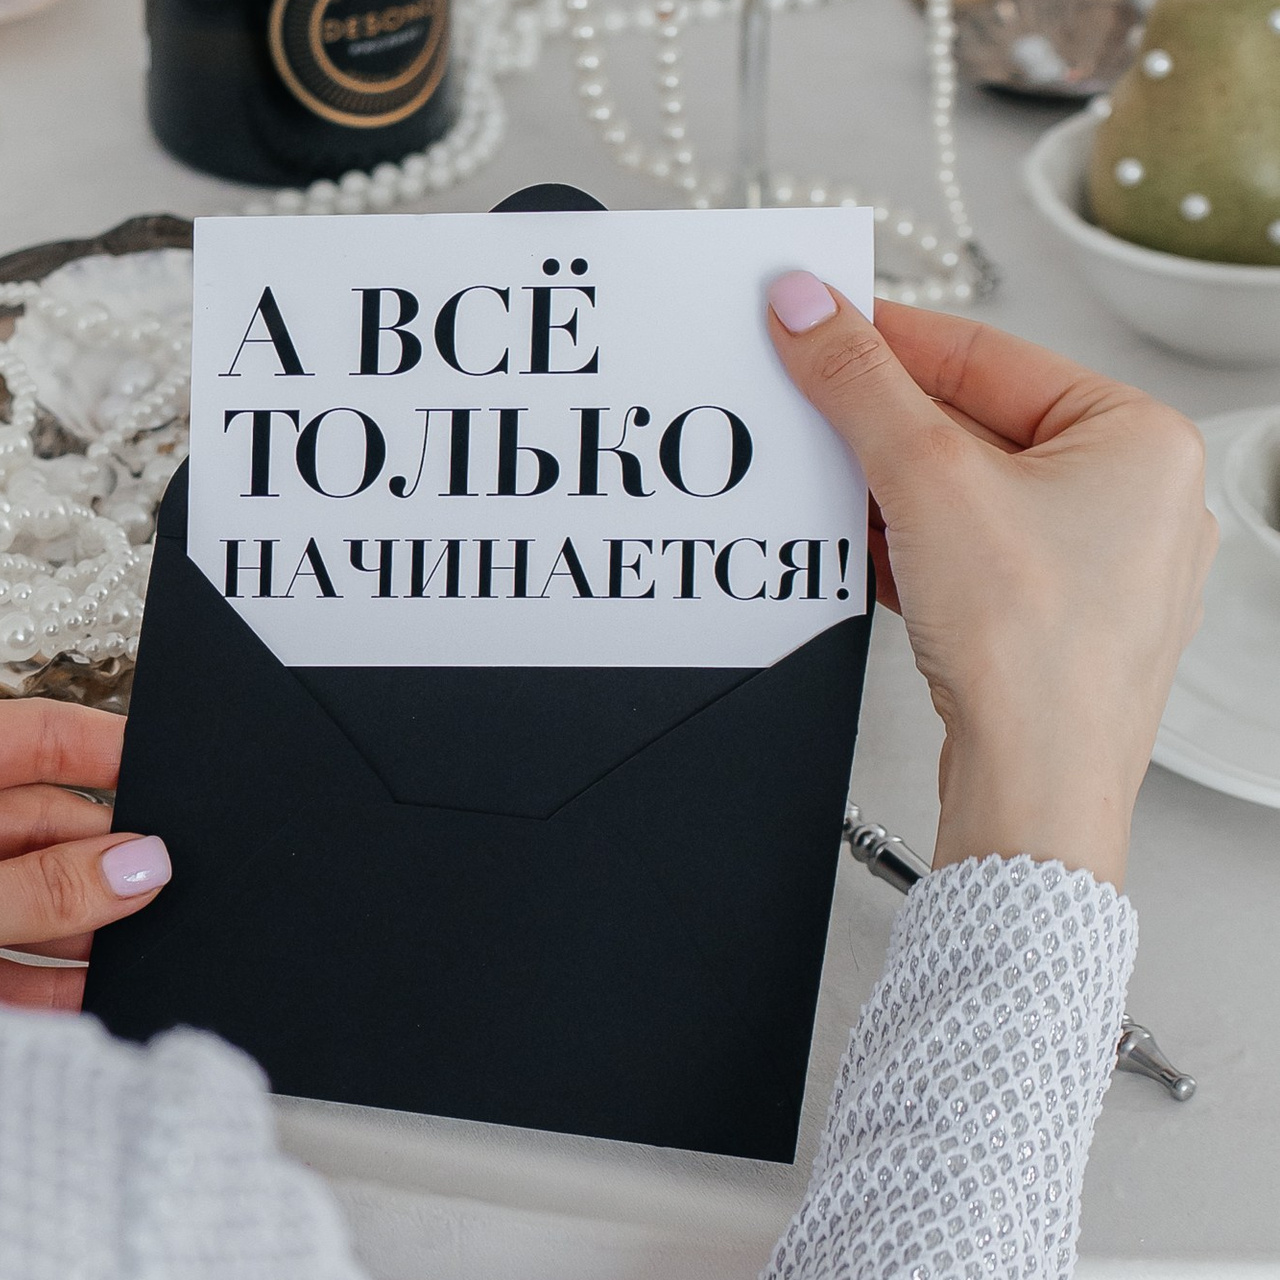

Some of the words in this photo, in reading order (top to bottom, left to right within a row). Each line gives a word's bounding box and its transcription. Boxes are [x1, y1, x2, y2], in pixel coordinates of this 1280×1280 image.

[218, 286, 316, 377] А
[348, 257, 600, 377] ВСЁ
[223, 405, 754, 499] ТОЛЬКО
[219, 536, 851, 601] НАЧИНАЕТСЯ!
